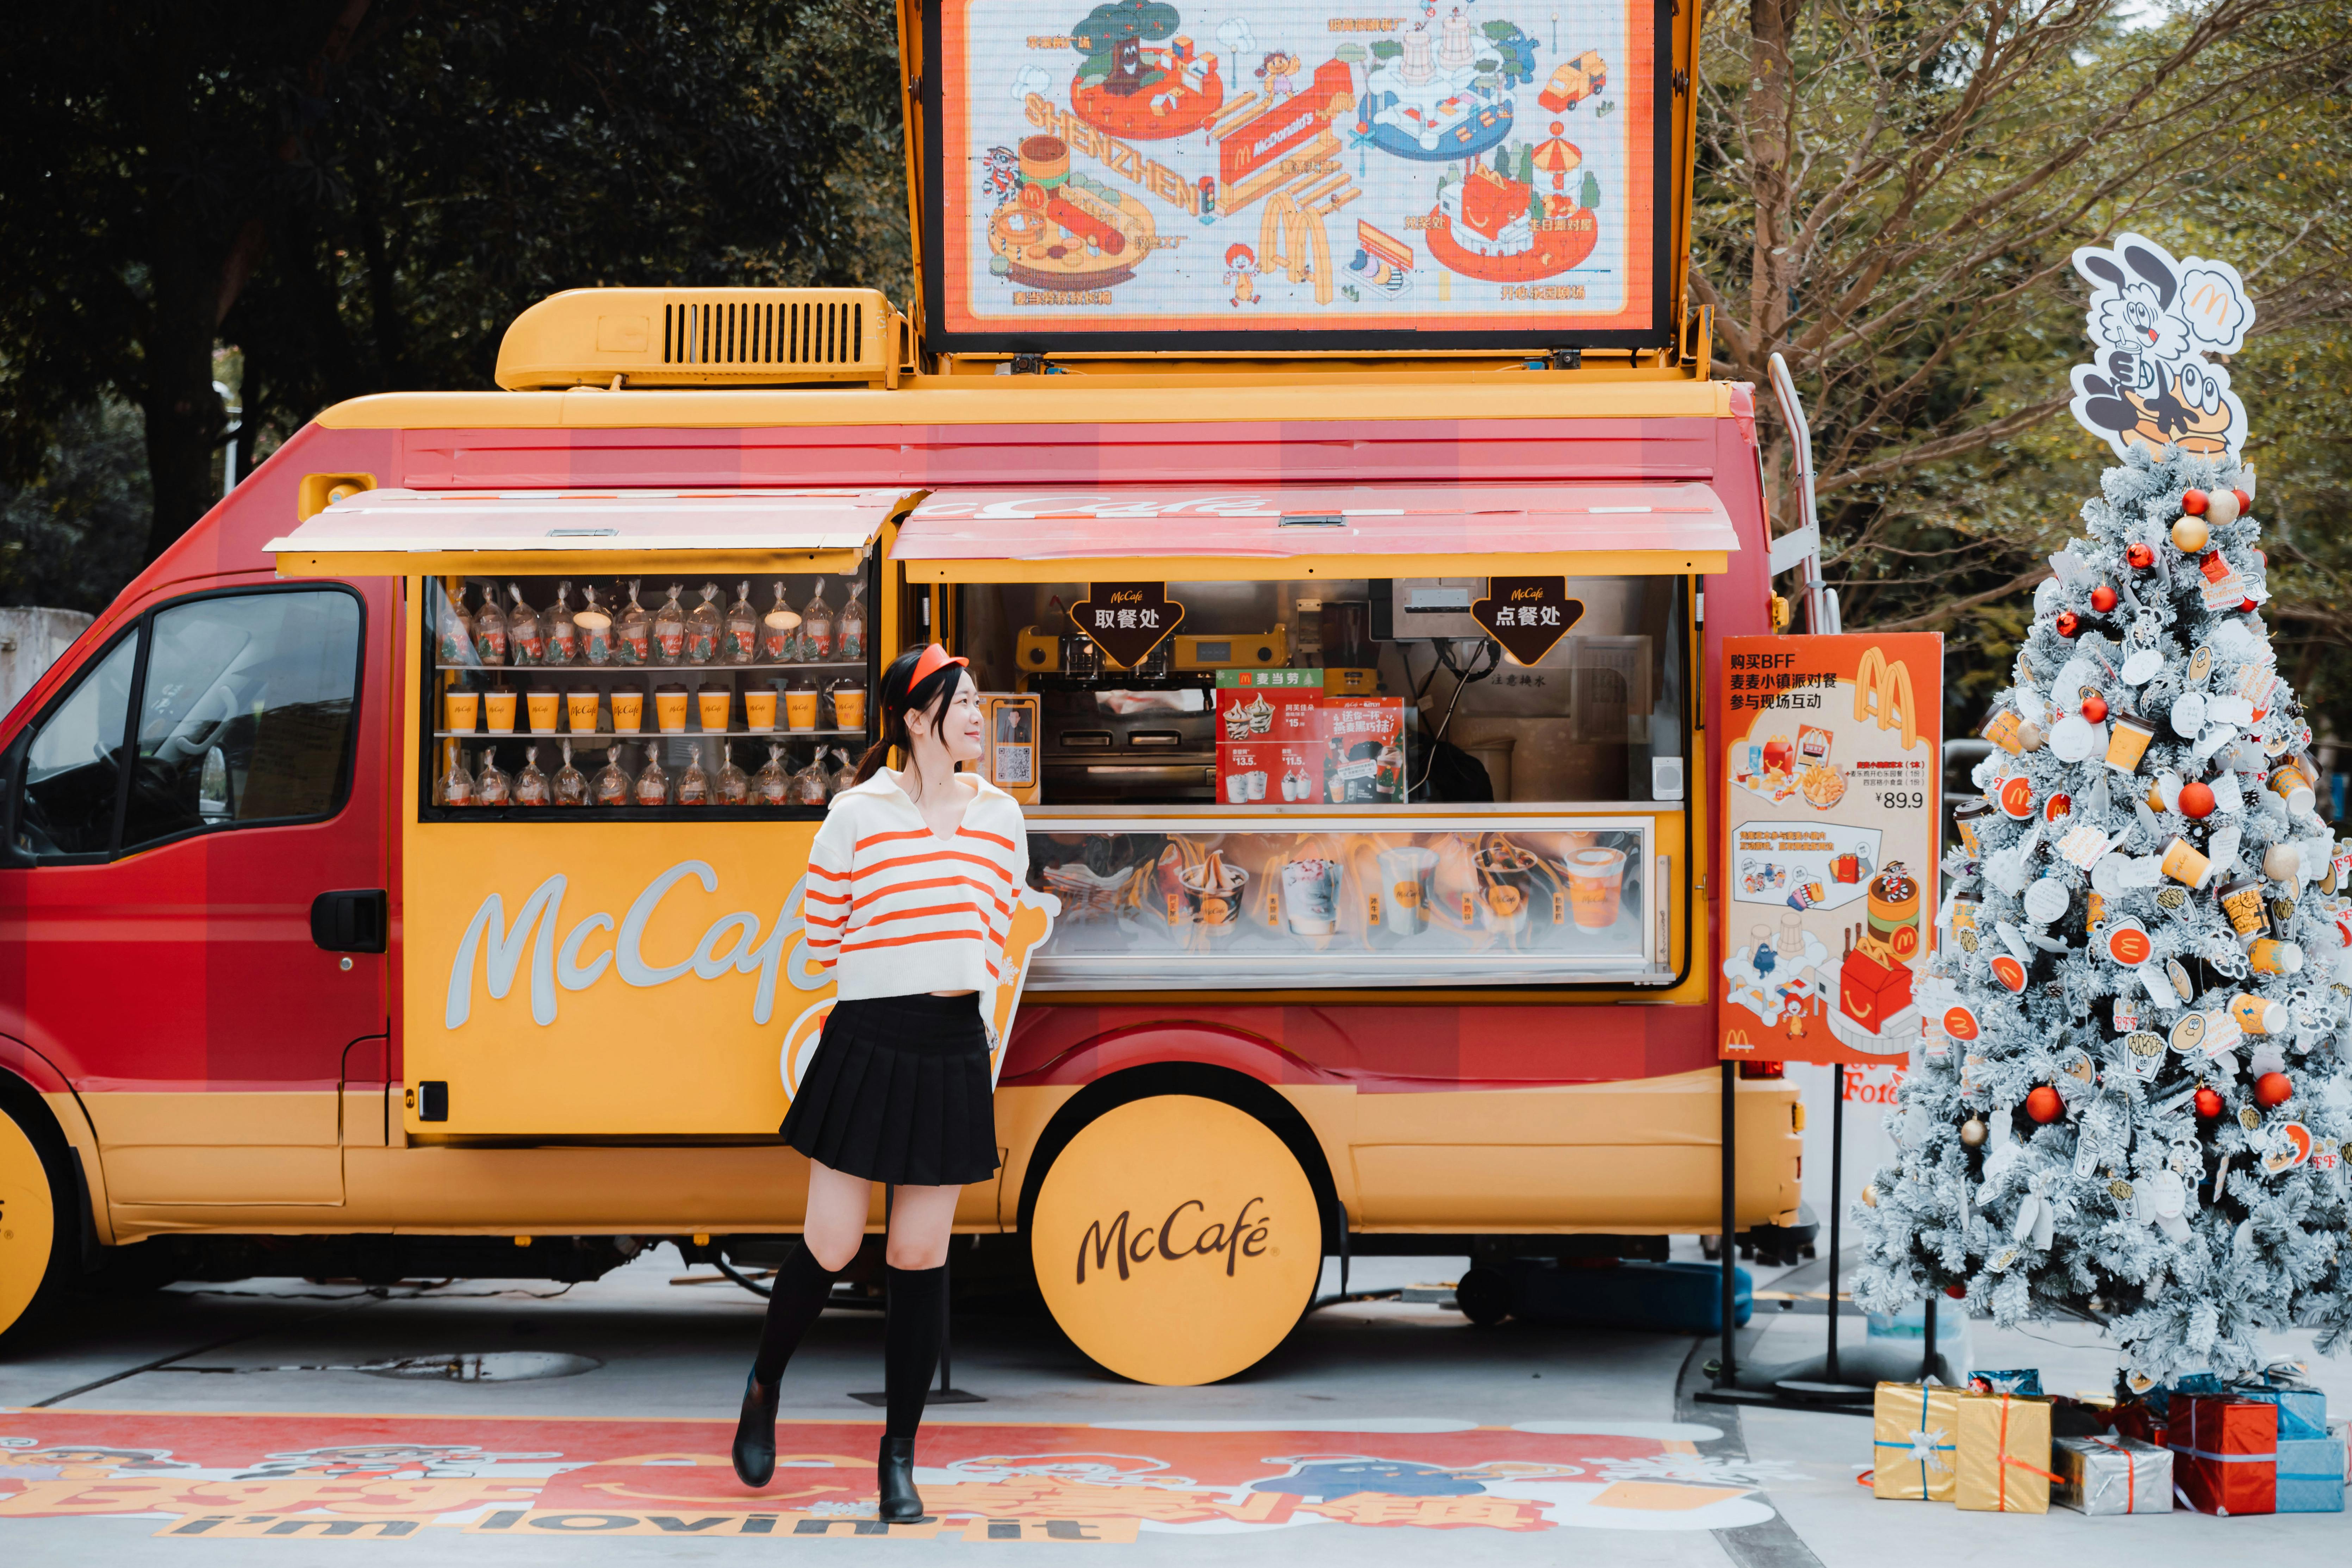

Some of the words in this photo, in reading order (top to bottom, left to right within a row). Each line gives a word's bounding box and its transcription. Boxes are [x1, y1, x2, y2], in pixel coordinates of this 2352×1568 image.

[1025, 92, 1199, 216] SHENZHEN
[1110, 590, 1143, 603] McCafé
[1511, 587, 1544, 601] McCafé
[2208, 597, 2244, 609] McDonald's
[1095, 609, 1159, 629] 取餐处
[1496, 606, 1561, 626] 点餐处
[1730, 653, 1796, 670] 购买BFF
[1256, 673, 1299, 685] 麦当劳
[1730, 672, 1837, 690] 麦麦小镇派对餐
[2260, 677, 2280, 708] McDonald's
[1730, 693, 1821, 710] 参与现场互动
[1875, 792, 1923, 808] ¥89.9
[2115, 1016, 2138, 1030] BFF
[1077, 1197, 1270, 1284] McCafé
[170, 1515, 421, 1537] i'm
[988, 1519, 1101, 1541] it
